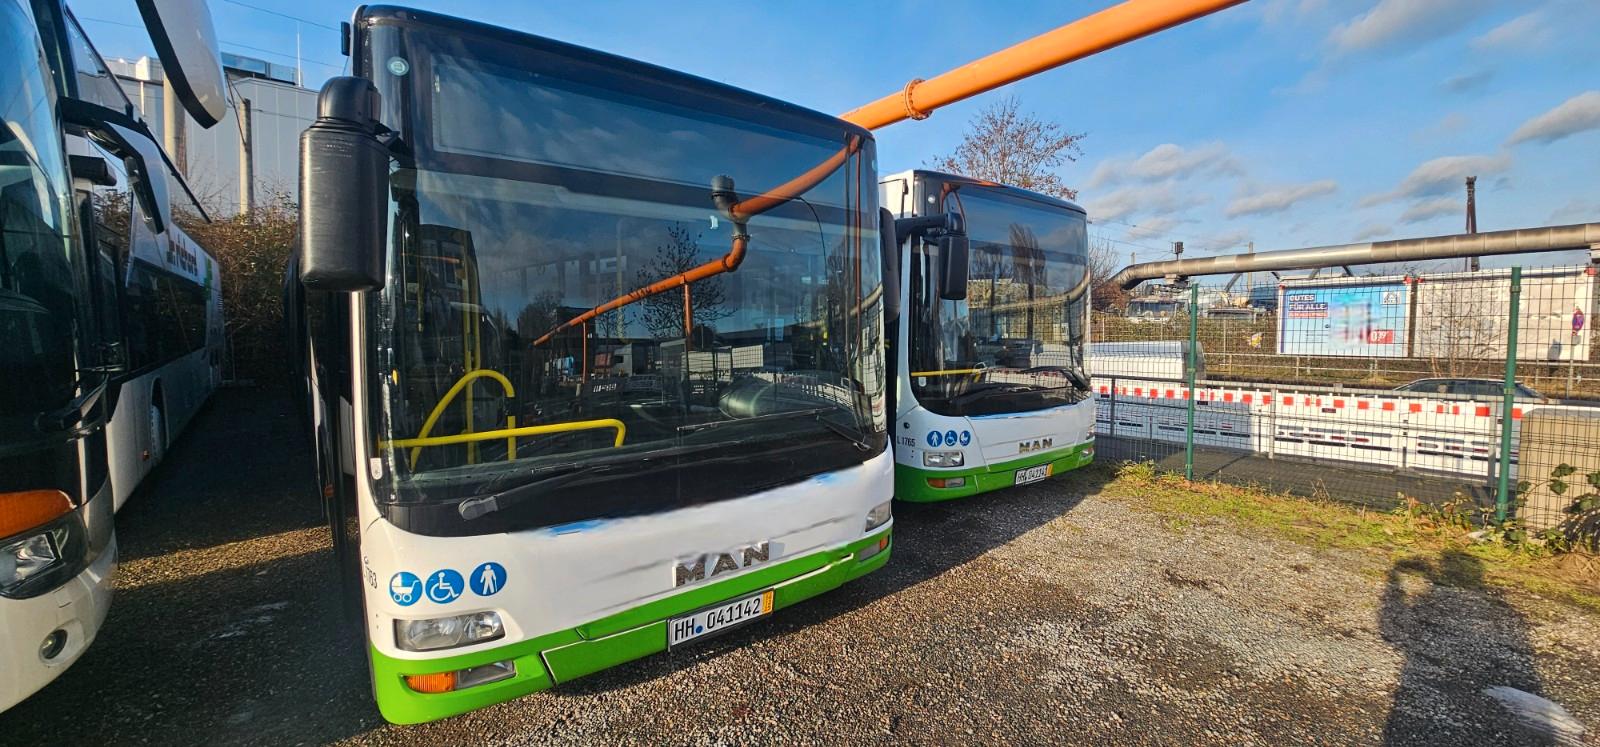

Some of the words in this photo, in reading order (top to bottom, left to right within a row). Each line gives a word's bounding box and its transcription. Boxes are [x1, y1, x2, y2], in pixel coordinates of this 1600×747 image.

[902, 436, 916, 447] 1765
[1019, 437, 1053, 454] MAN
[672, 541, 769, 588] MAN
[674, 618, 695, 641] HH
[706, 598, 761, 629] 041142
